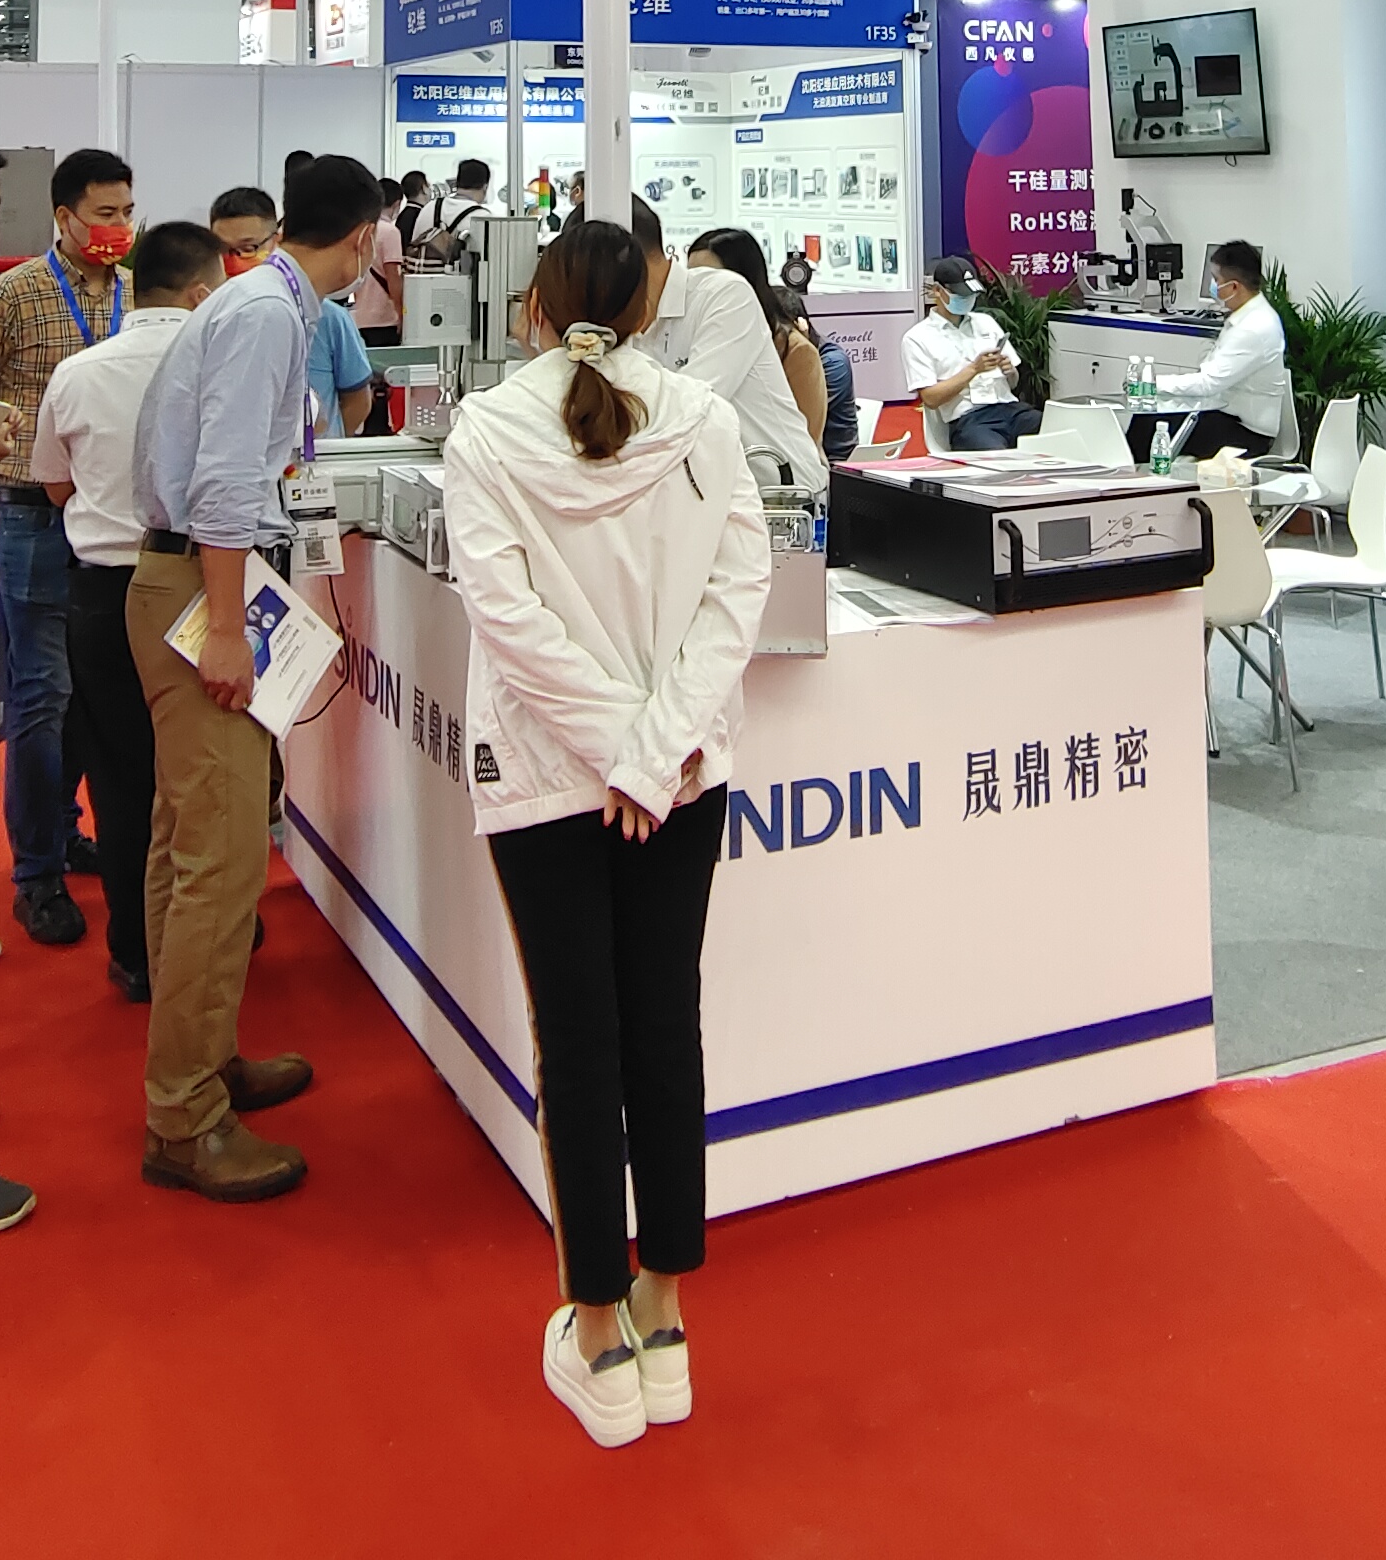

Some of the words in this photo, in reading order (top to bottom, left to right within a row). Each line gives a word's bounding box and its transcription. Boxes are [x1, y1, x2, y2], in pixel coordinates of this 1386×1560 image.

[865, 25, 897, 41] 1F35
[963, 19, 1034, 42] CFAN
[1008, 169, 1095, 192] 干硅量测
[412, 685, 470, 793] 晟鼎精
[963, 726, 1149, 822] 晟鼎精密
